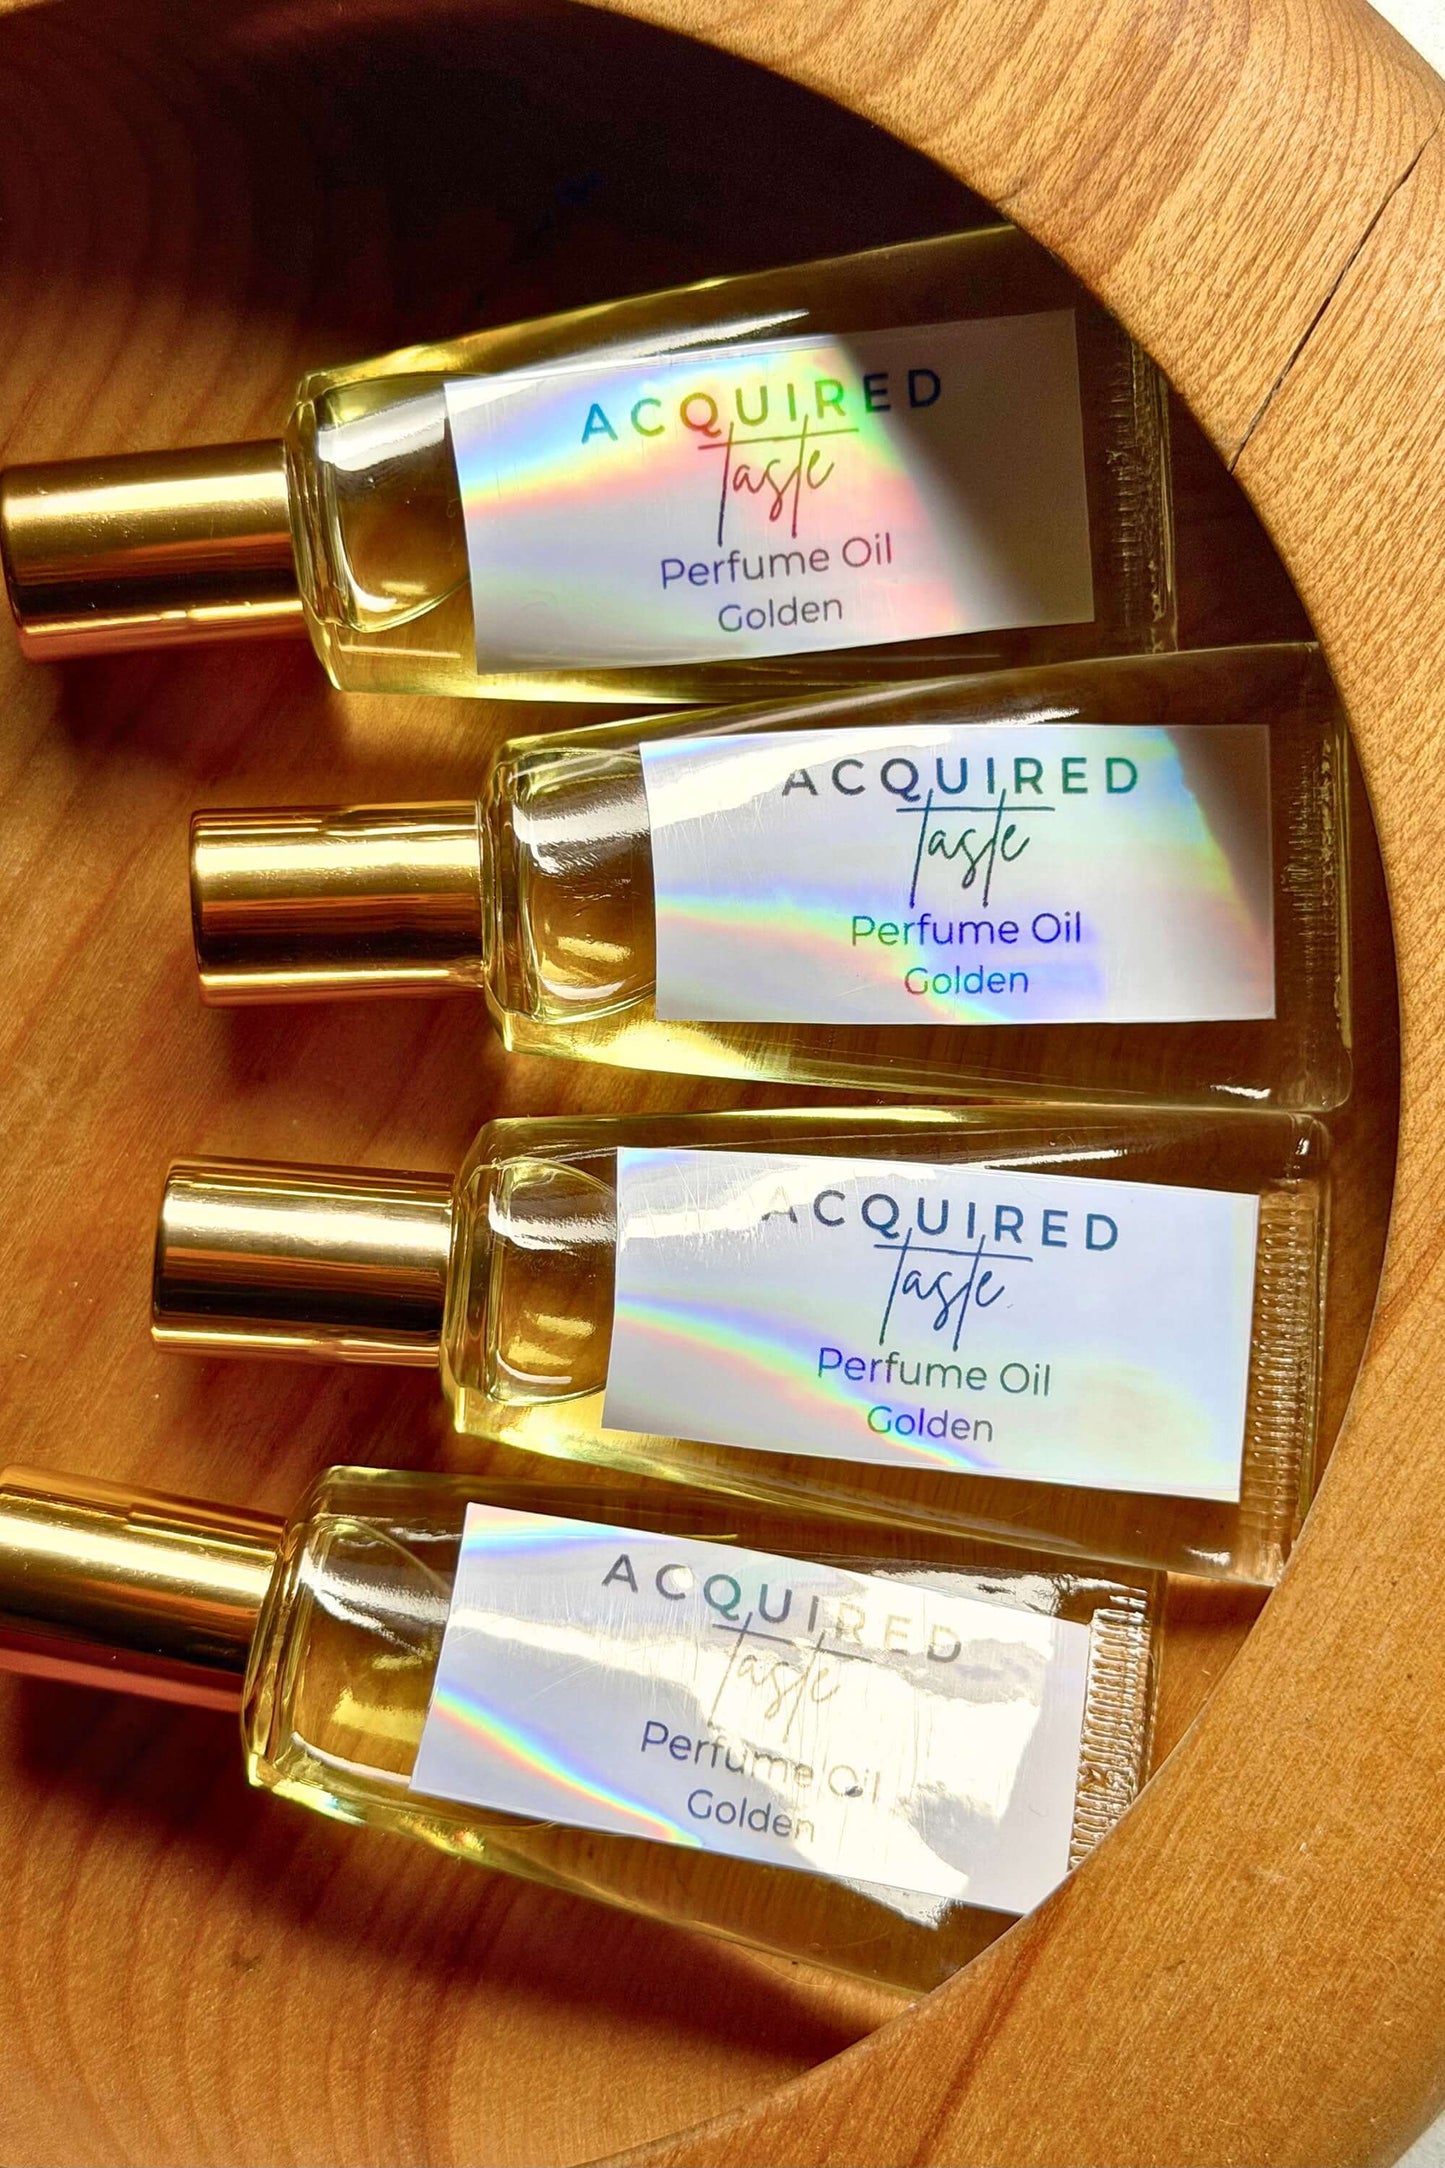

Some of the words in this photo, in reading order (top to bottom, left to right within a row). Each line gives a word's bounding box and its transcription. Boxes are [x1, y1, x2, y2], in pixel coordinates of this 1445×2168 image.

[581, 369, 941, 444] ACQUIRED
[660, 551, 830, 589] Perfume
[842, 532, 892, 568] Oil
[718, 597, 843, 632] Golden
[781, 757, 1138, 801] ACQUIRED
[851, 912, 1019, 947] Perfume
[1032, 911, 1081, 943] Oil
[904, 965, 1029, 994] Golden
[817, 1347, 987, 1390] Perfume
[1000, 1362, 1050, 1396] Oil
[867, 1406, 993, 1442] Golden
[602, 1554, 962, 1663] ACQUIRED
[640, 1720, 814, 1788] Perfume
[828, 1764, 880, 1804] Oil
[688, 1789, 815, 1842] Golden
